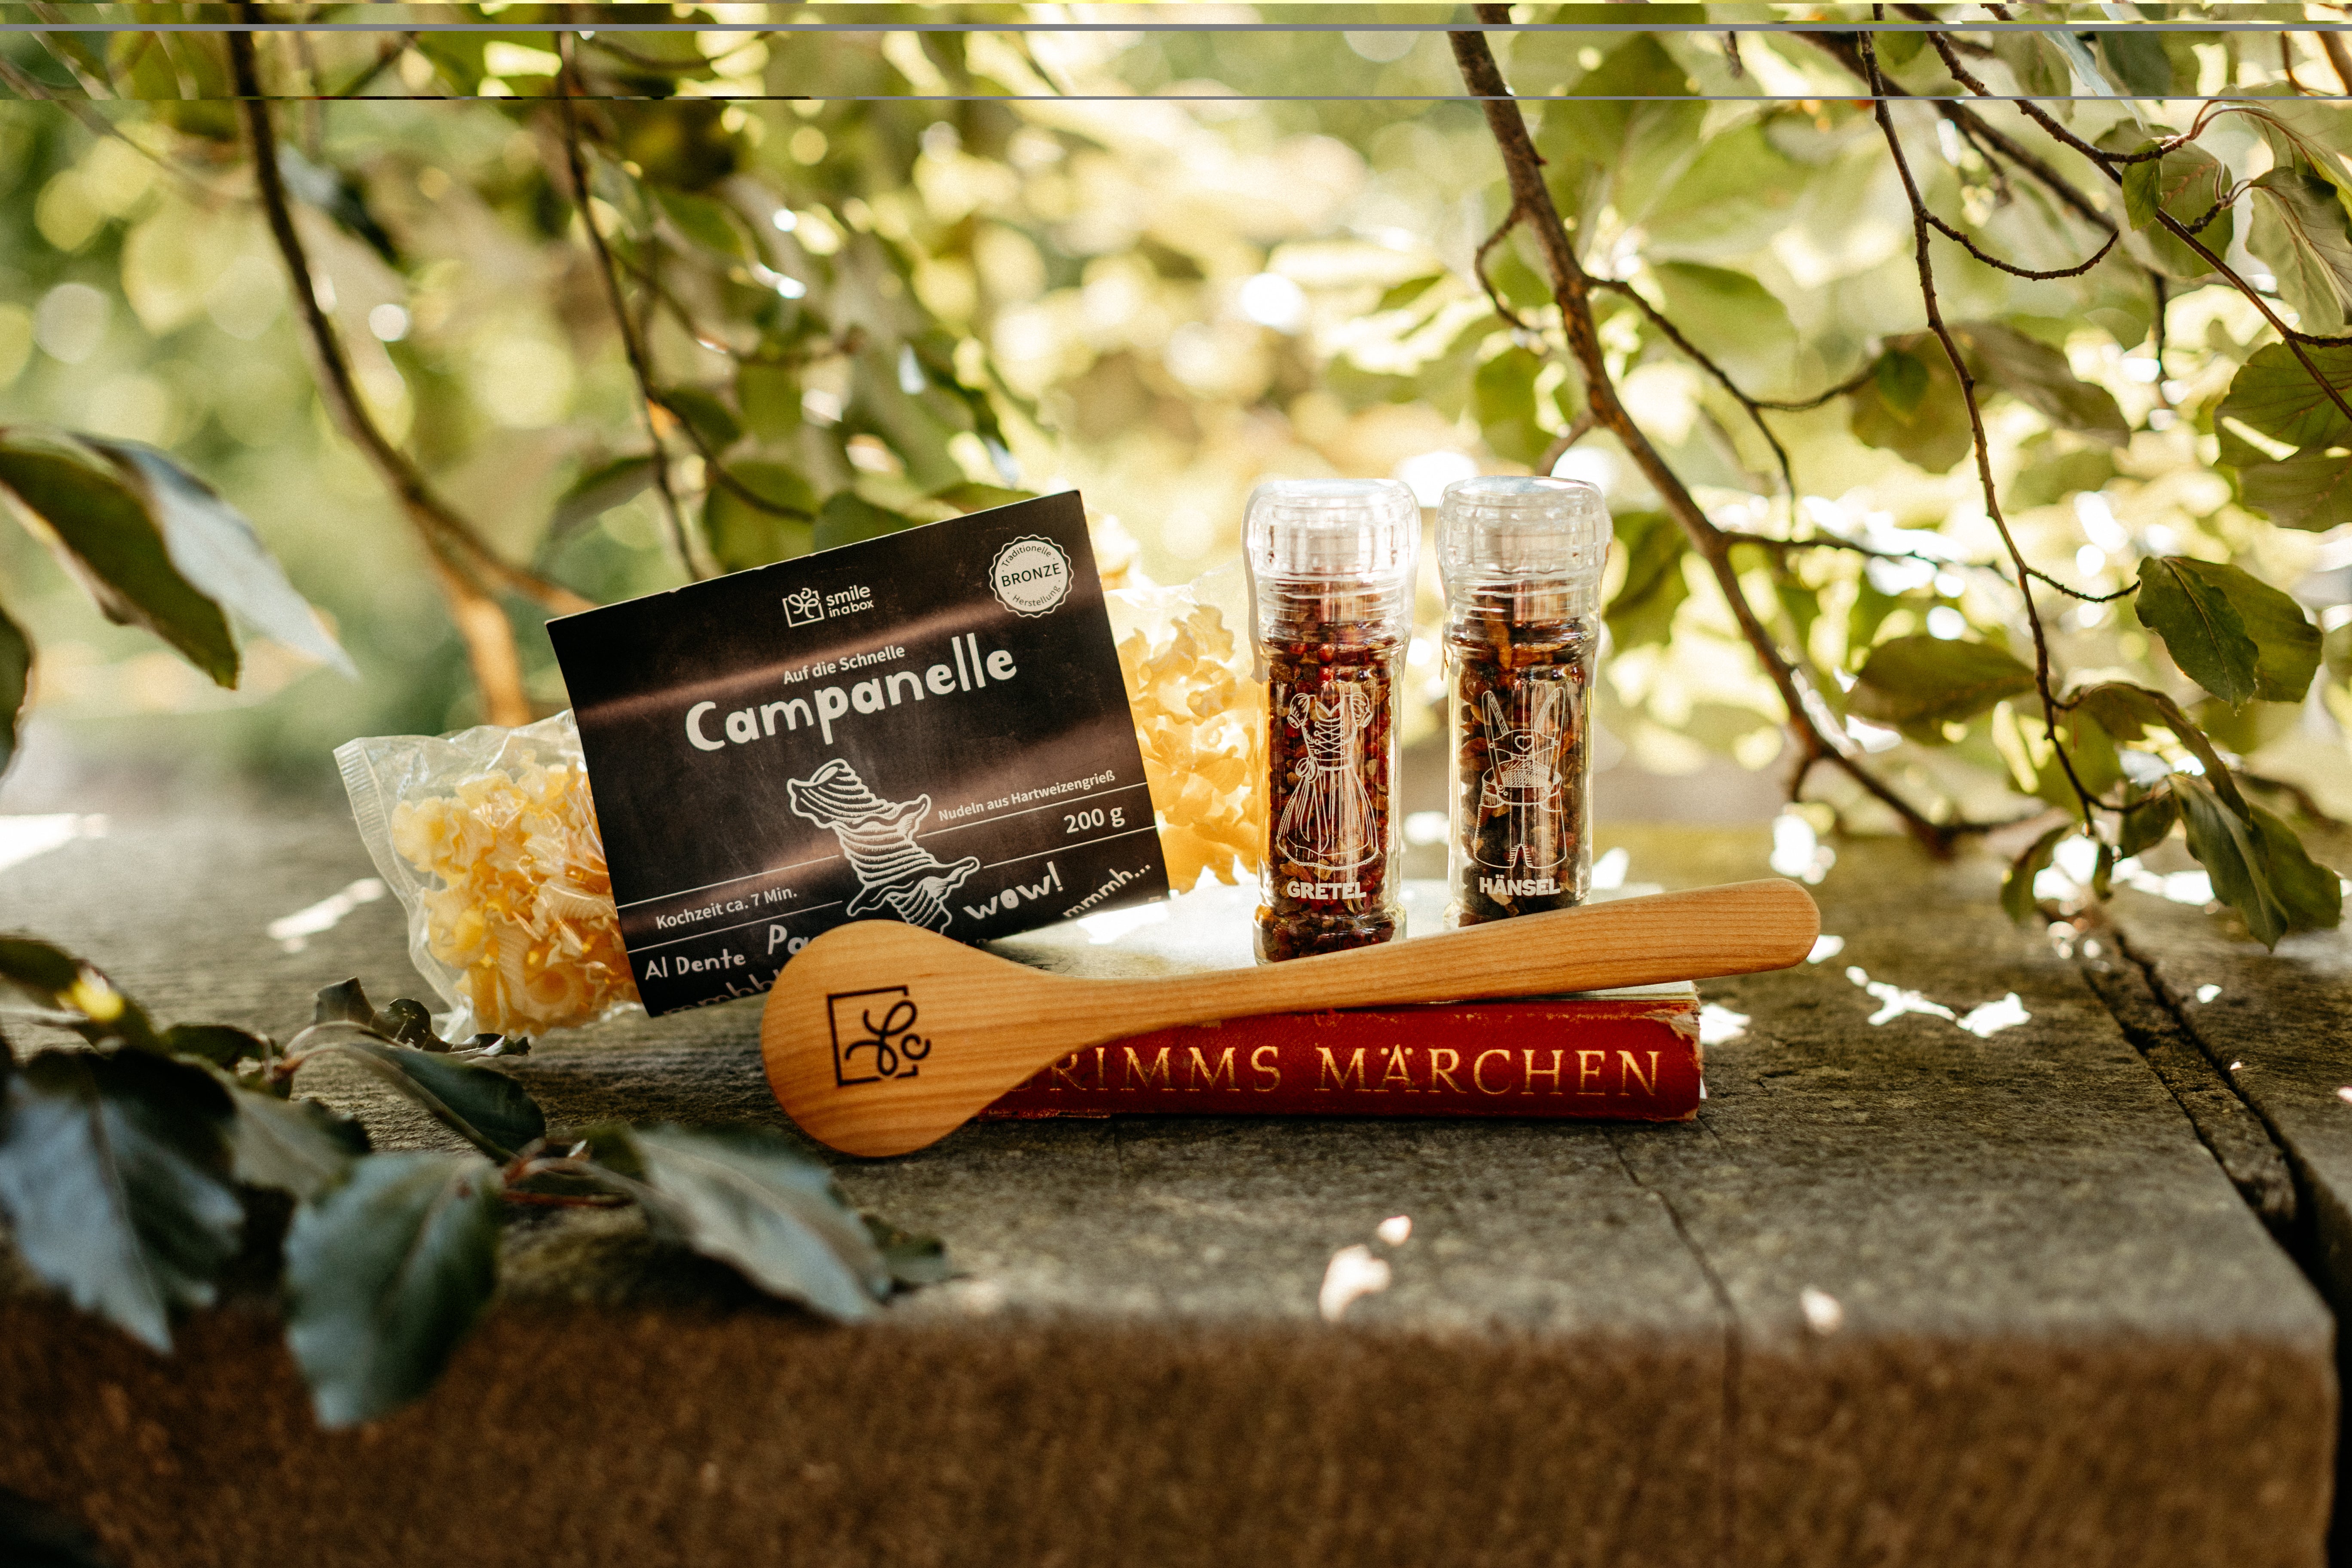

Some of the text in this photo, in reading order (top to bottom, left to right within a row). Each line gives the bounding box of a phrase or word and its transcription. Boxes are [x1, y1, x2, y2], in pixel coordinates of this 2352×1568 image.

[1001, 545, 1051, 567] Traditionelle
[1001, 562, 1061, 587] BRONZE
[826, 585, 870, 606] smile
[1012, 585, 1061, 606] Herstellung
[784, 645, 905, 684] Auf die Schnelle
[685, 632, 1017, 751] Campanelle
[938, 769, 1115, 821] Nudeln aus Hartweizengrieß
[1063, 807, 1125, 833] 200 g
[963, 861, 1064, 920] wow!
[1286, 880, 1366, 900] GRETEL
[1479, 874, 1561, 896] HÄNSEL
[656, 887, 798, 930] Kochzeit ca. 7 Min.
[767, 924, 810, 955] Pa
[645, 949, 746, 980] Al Dente
[1009, 1043, 1660, 1096] RIMMS MÄRCHEN
